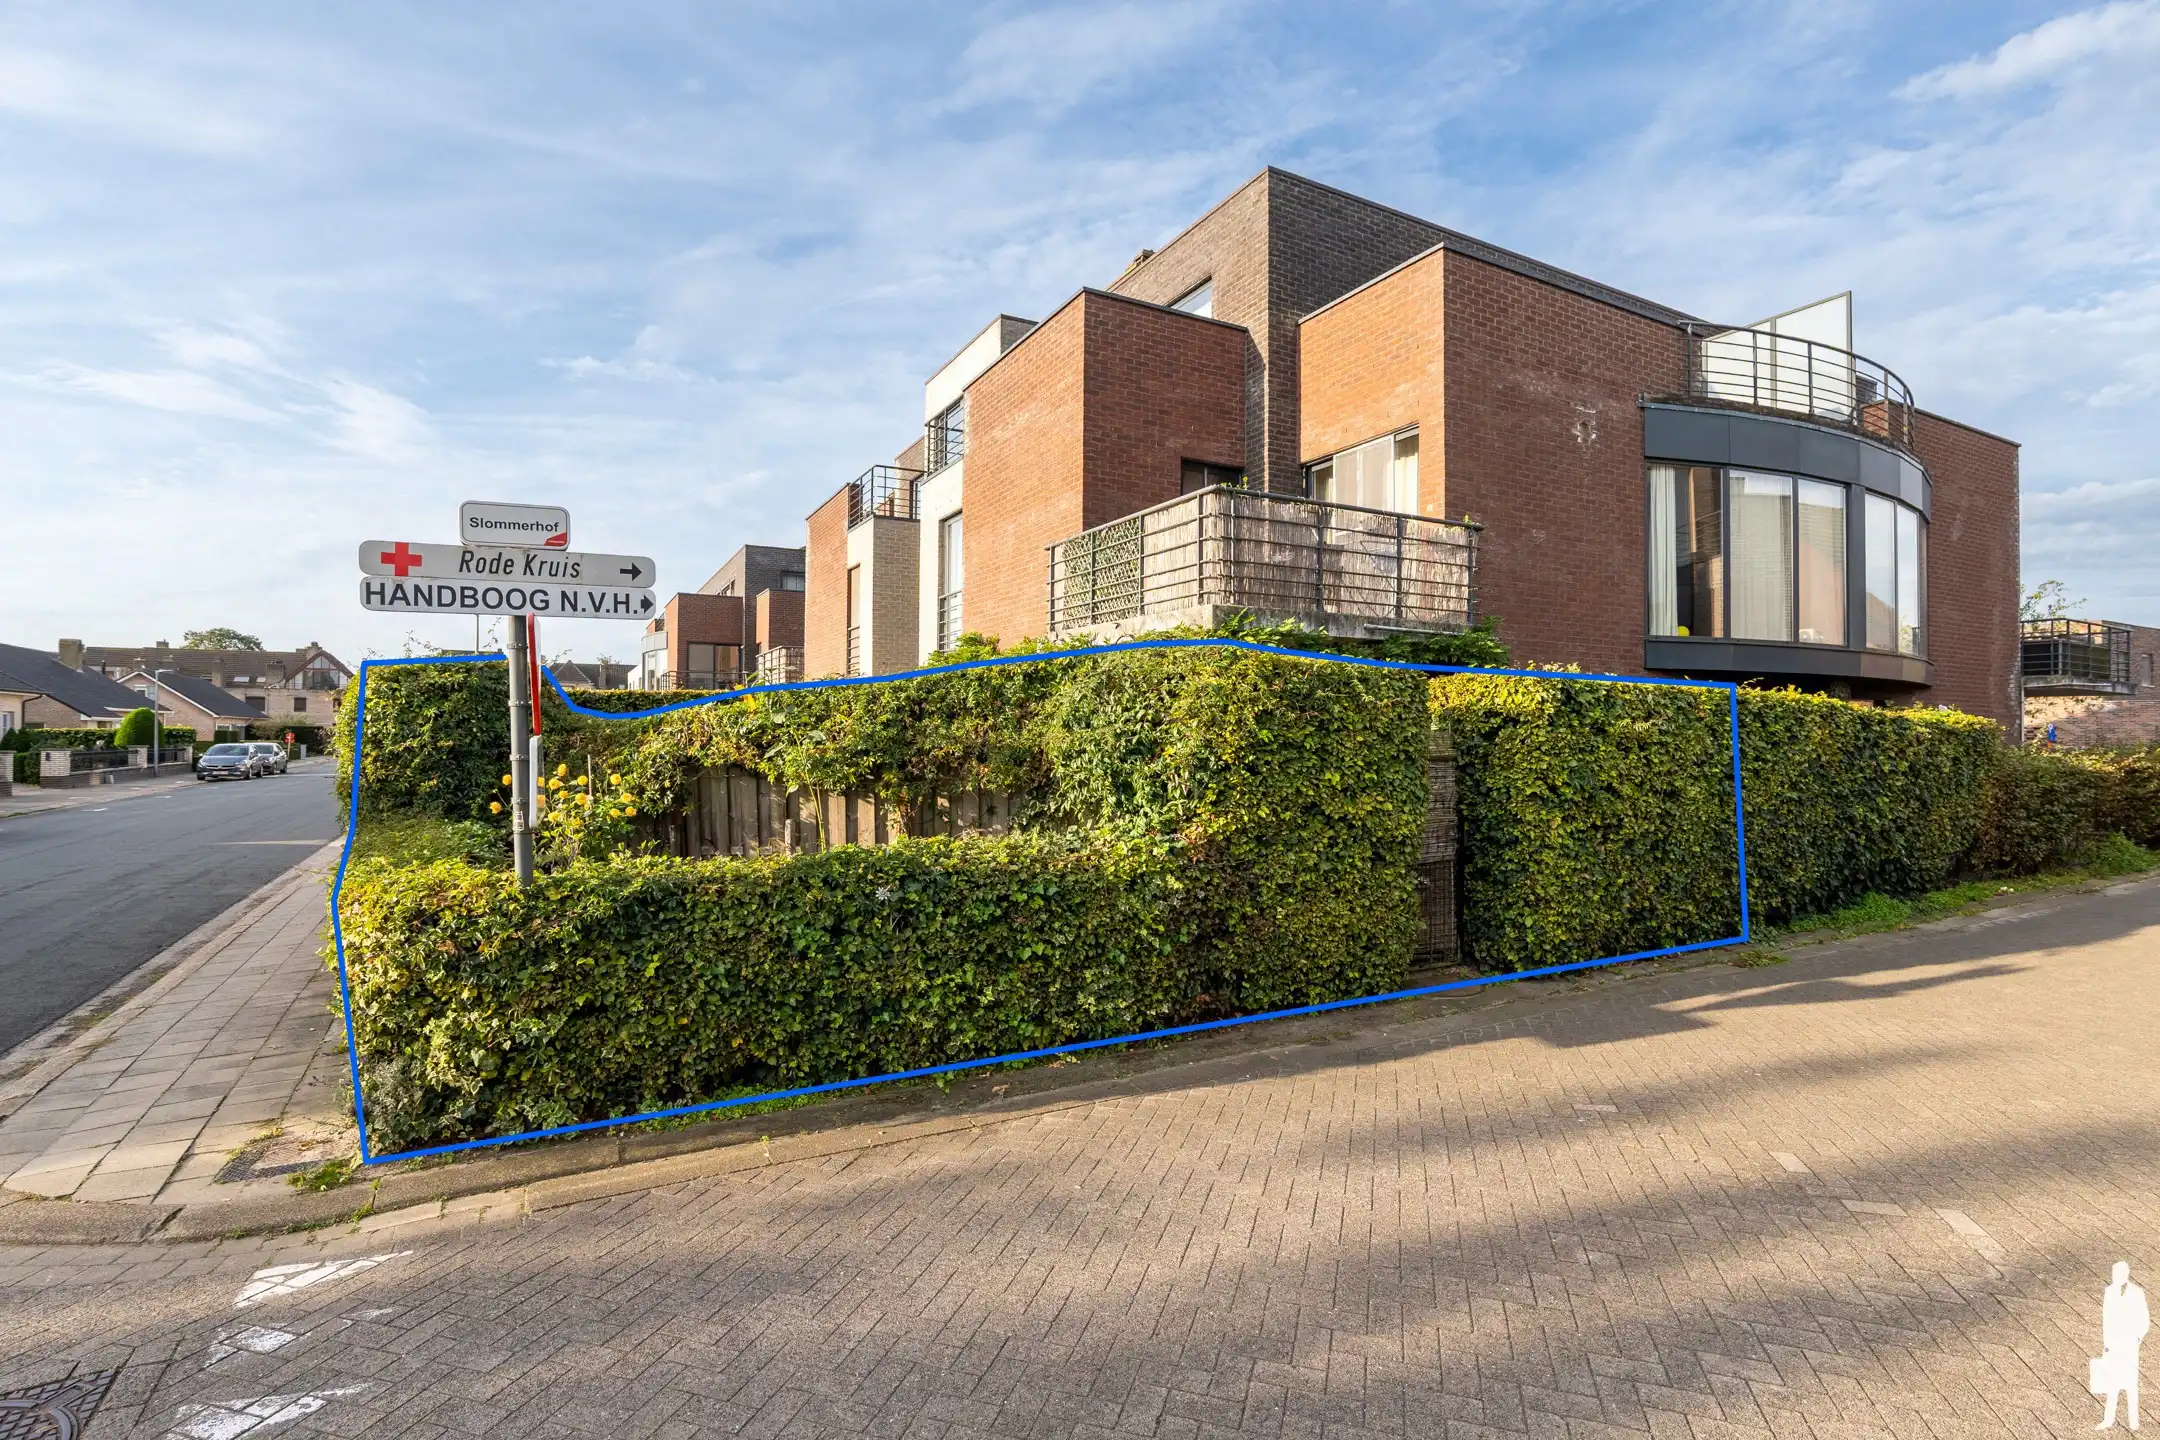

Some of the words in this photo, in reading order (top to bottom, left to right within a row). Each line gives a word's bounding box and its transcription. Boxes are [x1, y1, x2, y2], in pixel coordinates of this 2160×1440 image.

[469, 516, 559, 532] Slommerhof
[459, 550, 514, 575] Rode
[523, 554, 581, 578] Kruis
[365, 581, 550, 611] HANDBOOG
[560, 590, 639, 614] N.V.H.
